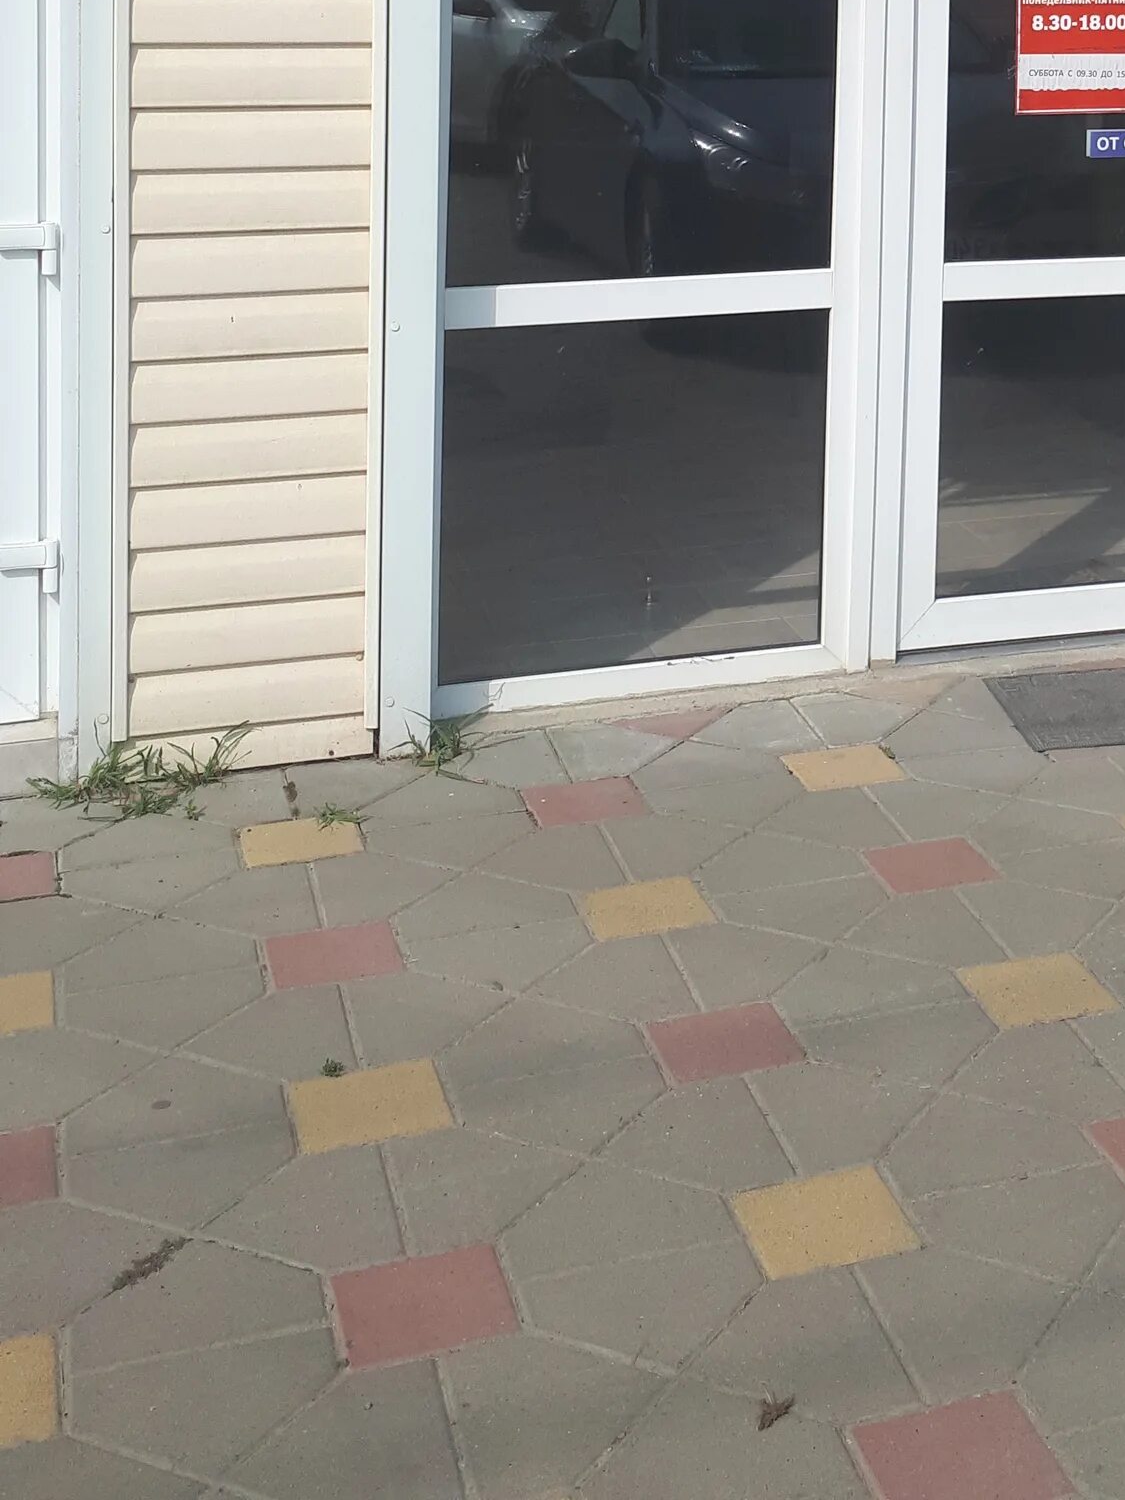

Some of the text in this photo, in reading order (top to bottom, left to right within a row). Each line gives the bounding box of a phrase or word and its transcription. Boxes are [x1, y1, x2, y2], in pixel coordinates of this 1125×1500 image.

[1028, 69, 1064, 78] СУББОТА
[1068, 70, 1073, 78] С
[1076, 69, 1098, 78] 09.30
[1101, 70, 1113, 79] ДО
[1096, 137, 1120, 151] ОТ
